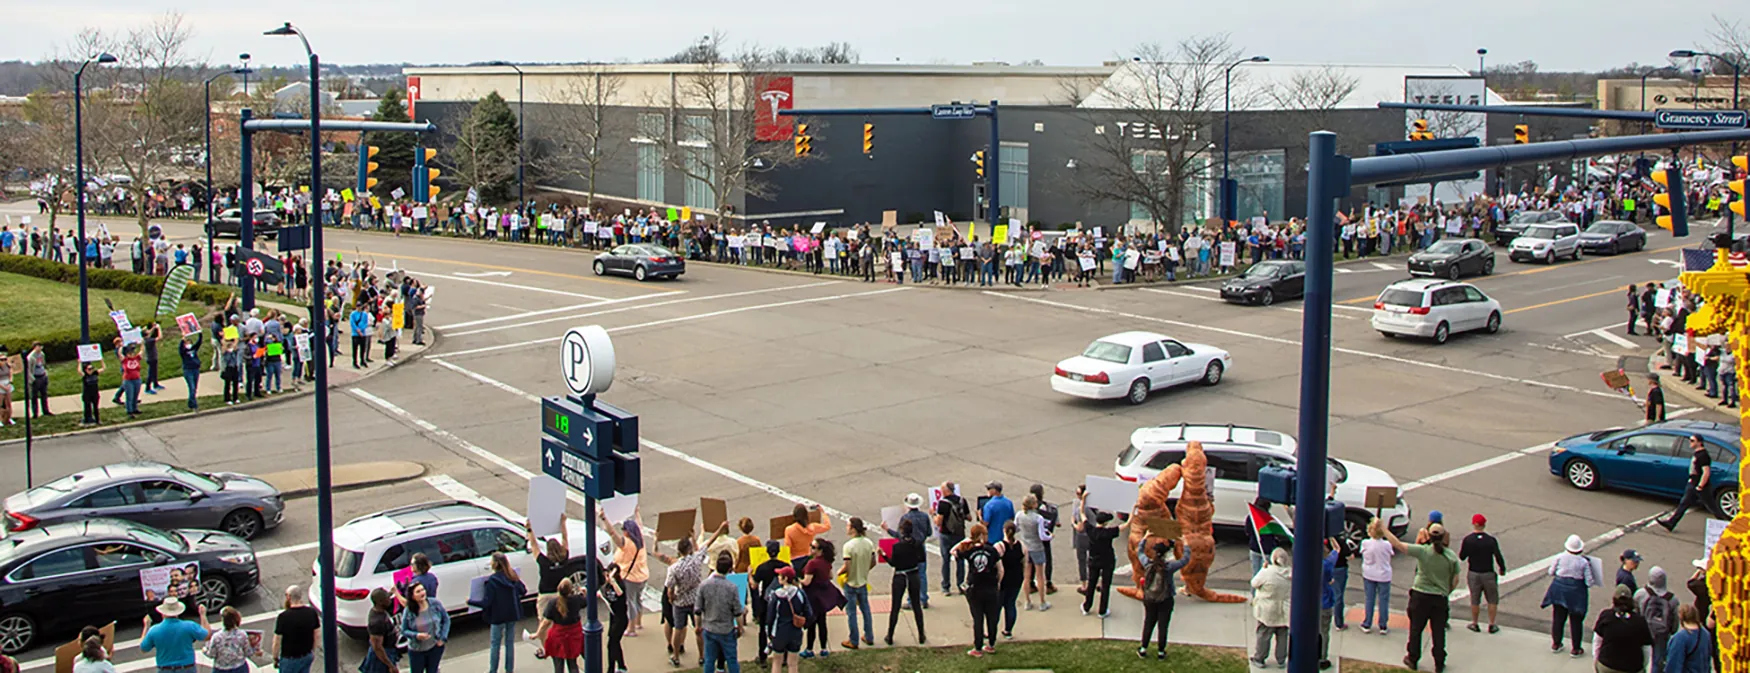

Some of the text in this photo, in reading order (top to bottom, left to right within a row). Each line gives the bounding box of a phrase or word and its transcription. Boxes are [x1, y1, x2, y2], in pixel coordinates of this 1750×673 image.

[1659, 112, 1742, 127] Gramercy Street
[568, 340, 584, 382] P
[555, 413, 569, 434] 18
[561, 450, 594, 479] ADDITIONAL
[561, 468, 586, 490] PARKING
